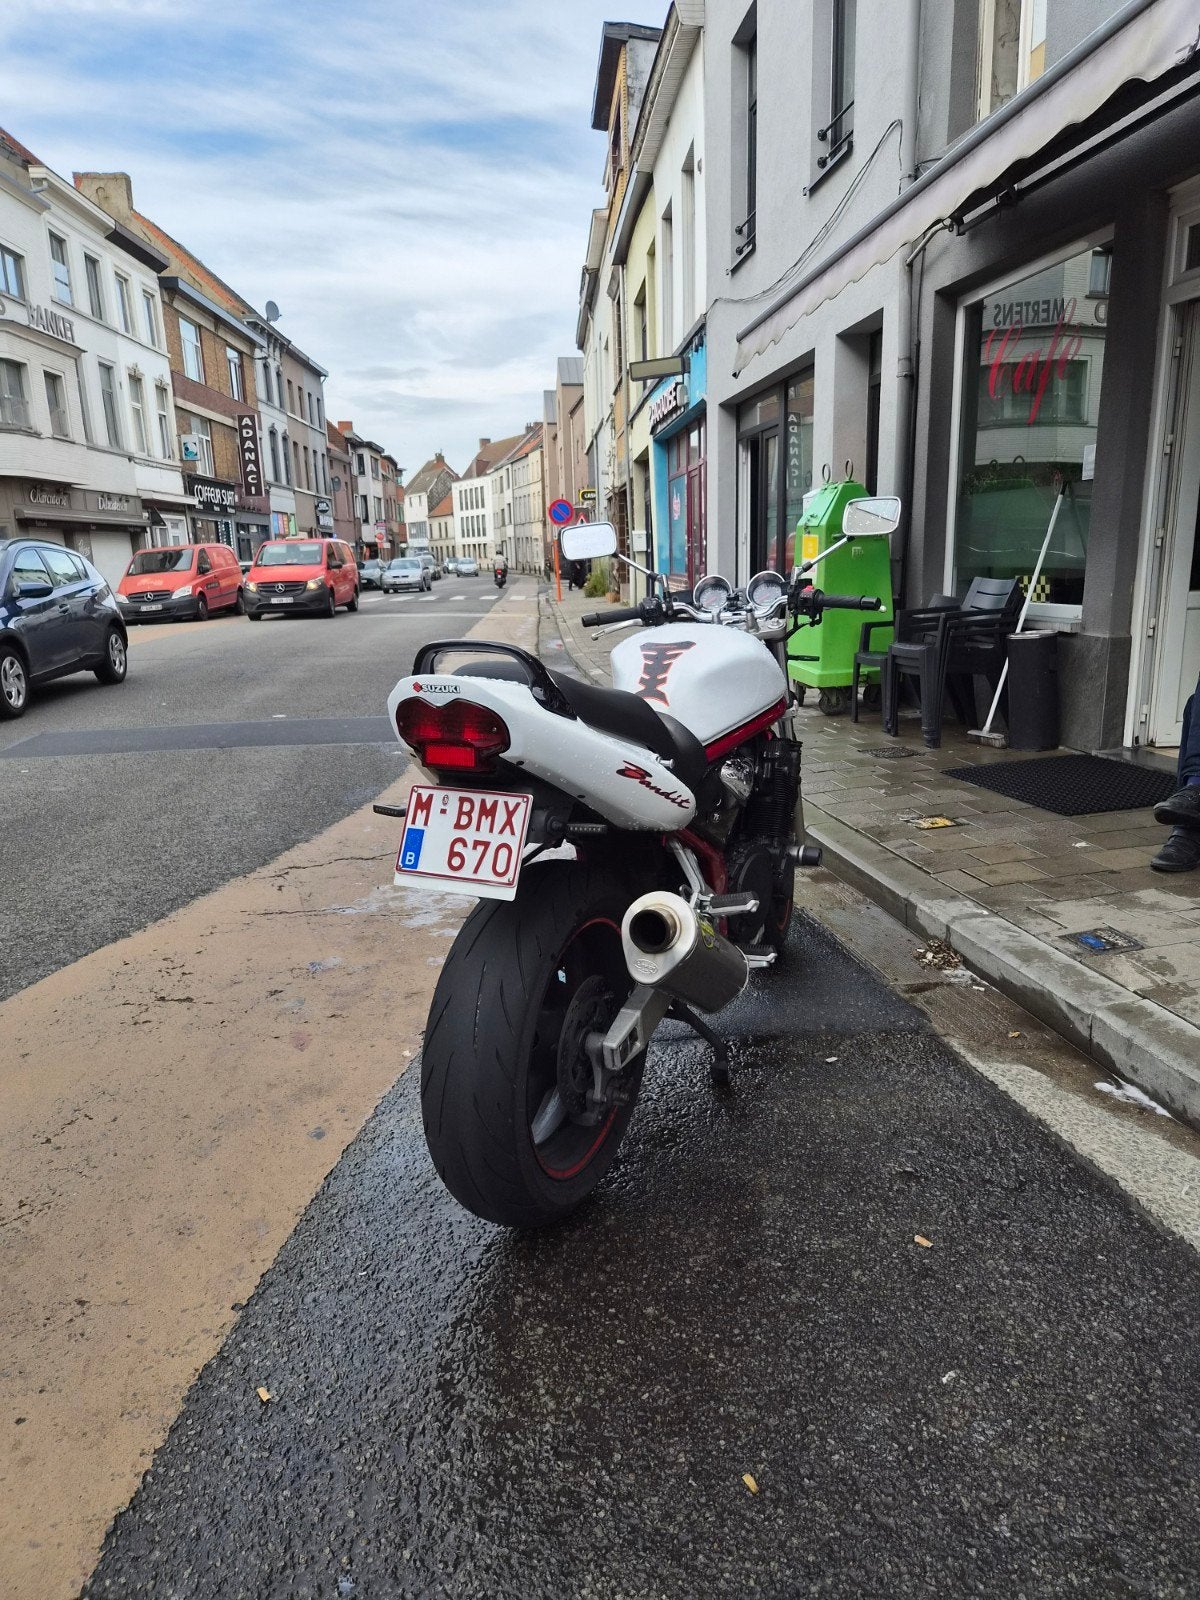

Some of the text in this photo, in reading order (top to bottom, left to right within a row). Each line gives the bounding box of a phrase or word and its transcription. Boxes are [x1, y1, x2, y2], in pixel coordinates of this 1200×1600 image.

[26, 301, 76, 344] BANKET
[241, 417, 258, 495] ADANACI
[194, 484, 221, 504] COIFFEUR
[421, 684, 461, 694] SUZUKI
[616, 760, 691, 809] Bandit
[405, 851, 416, 865] B
[447, 837, 513, 878] 670
